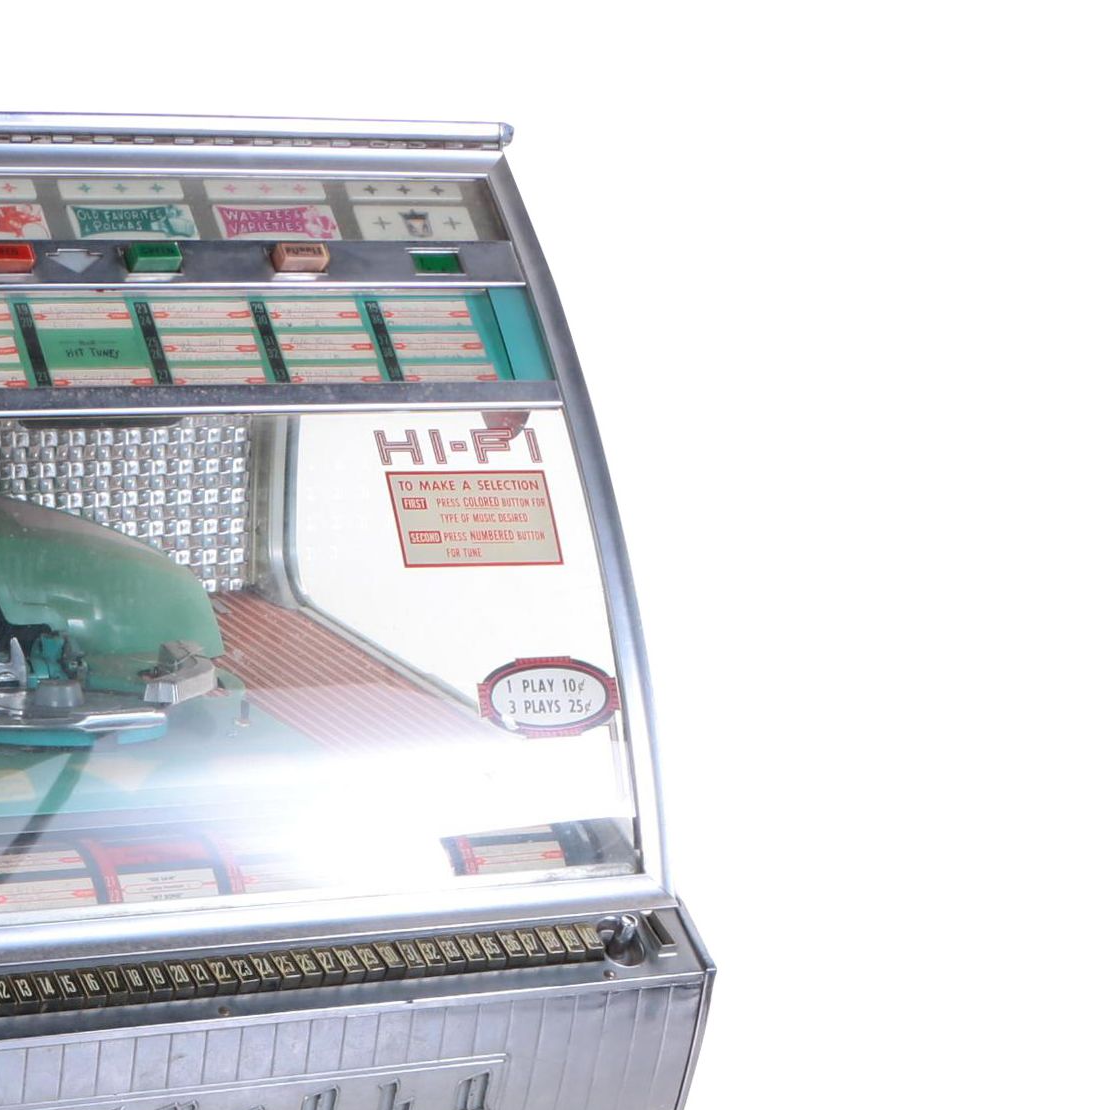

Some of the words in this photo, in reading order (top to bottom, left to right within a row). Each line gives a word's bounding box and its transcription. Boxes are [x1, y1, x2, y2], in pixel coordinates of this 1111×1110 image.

[76, 209, 99, 220] OLD
[104, 208, 163, 221] FAVORITES
[224, 209, 291, 221] WALTZES
[93, 219, 142, 231] POLKAS
[227, 221, 304, 234] VARIETIES
[66, 349, 84, 359] HIT
[90, 347, 119, 359] TUNES
[373, 427, 542, 465] HI-FI
[398, 480, 413, 491] TO
[419, 480, 456, 491] MAKE
[462, 480, 472, 490] A
[478, 480, 540, 491] SELECTION
[403, 498, 427, 509] FIRST
[436, 498, 461, 508] PRESS
[463, 496, 500, 507] COLORED
[501, 497, 530, 507] BUTTON
[532, 497, 547, 506] FOR
[440, 513, 458, 523] TYPE
[461, 513, 470, 522] OF
[473, 513, 497, 523] MUSIC
[499, 513, 528, 522] DESIRED
[410, 532, 441, 543] SECOND
[443, 531, 468, 541] PRESS
[470, 529, 514, 541] NUMBERED
[517, 530, 545, 540] BUTTON
[446, 548, 461, 558] FOR
[463, 548, 482, 558] TUNE
[506, 680, 512, 693] 1
[522, 679, 555, 693] PLAY
[562, 678, 586, 694] 10¢
[508, 700, 516, 714] 3
[524, 700, 561, 714] PLAYS
[569, 699, 593, 714] 25¢
[15, 979, 33, 997] 13
[37, 977, 55, 994] 14
[59, 975, 76, 992] 15
[82, 973, 99, 990] 16
[104, 971, 119, 988] 17
[128, 969, 143, 986] 18
[150, 967, 166, 984] 19
[171, 965, 189, 983] 20
[191, 963, 208, 981] 21
[212, 962, 231, 979] 22
[234, 959, 251, 976] 23
[255, 957, 274, 975] 24
[277, 956, 295, 973] 25
[297, 954, 316, 971] 26
[317, 952, 335, 969] 27
[341, 950, 359, 967] 28
[361, 948, 379, 965] 29
[405, 946, 421, 963] 31
[423, 943, 440, 959] 32
[443, 941, 460, 957] 33
[463, 940, 480, 956] 34
[482, 937, 500, 954] 35
[503, 935, 520, 951] 36
[523, 933, 538, 949] 37
[544, 931, 561, 948] 38
[563, 930, 580, 946] 39
